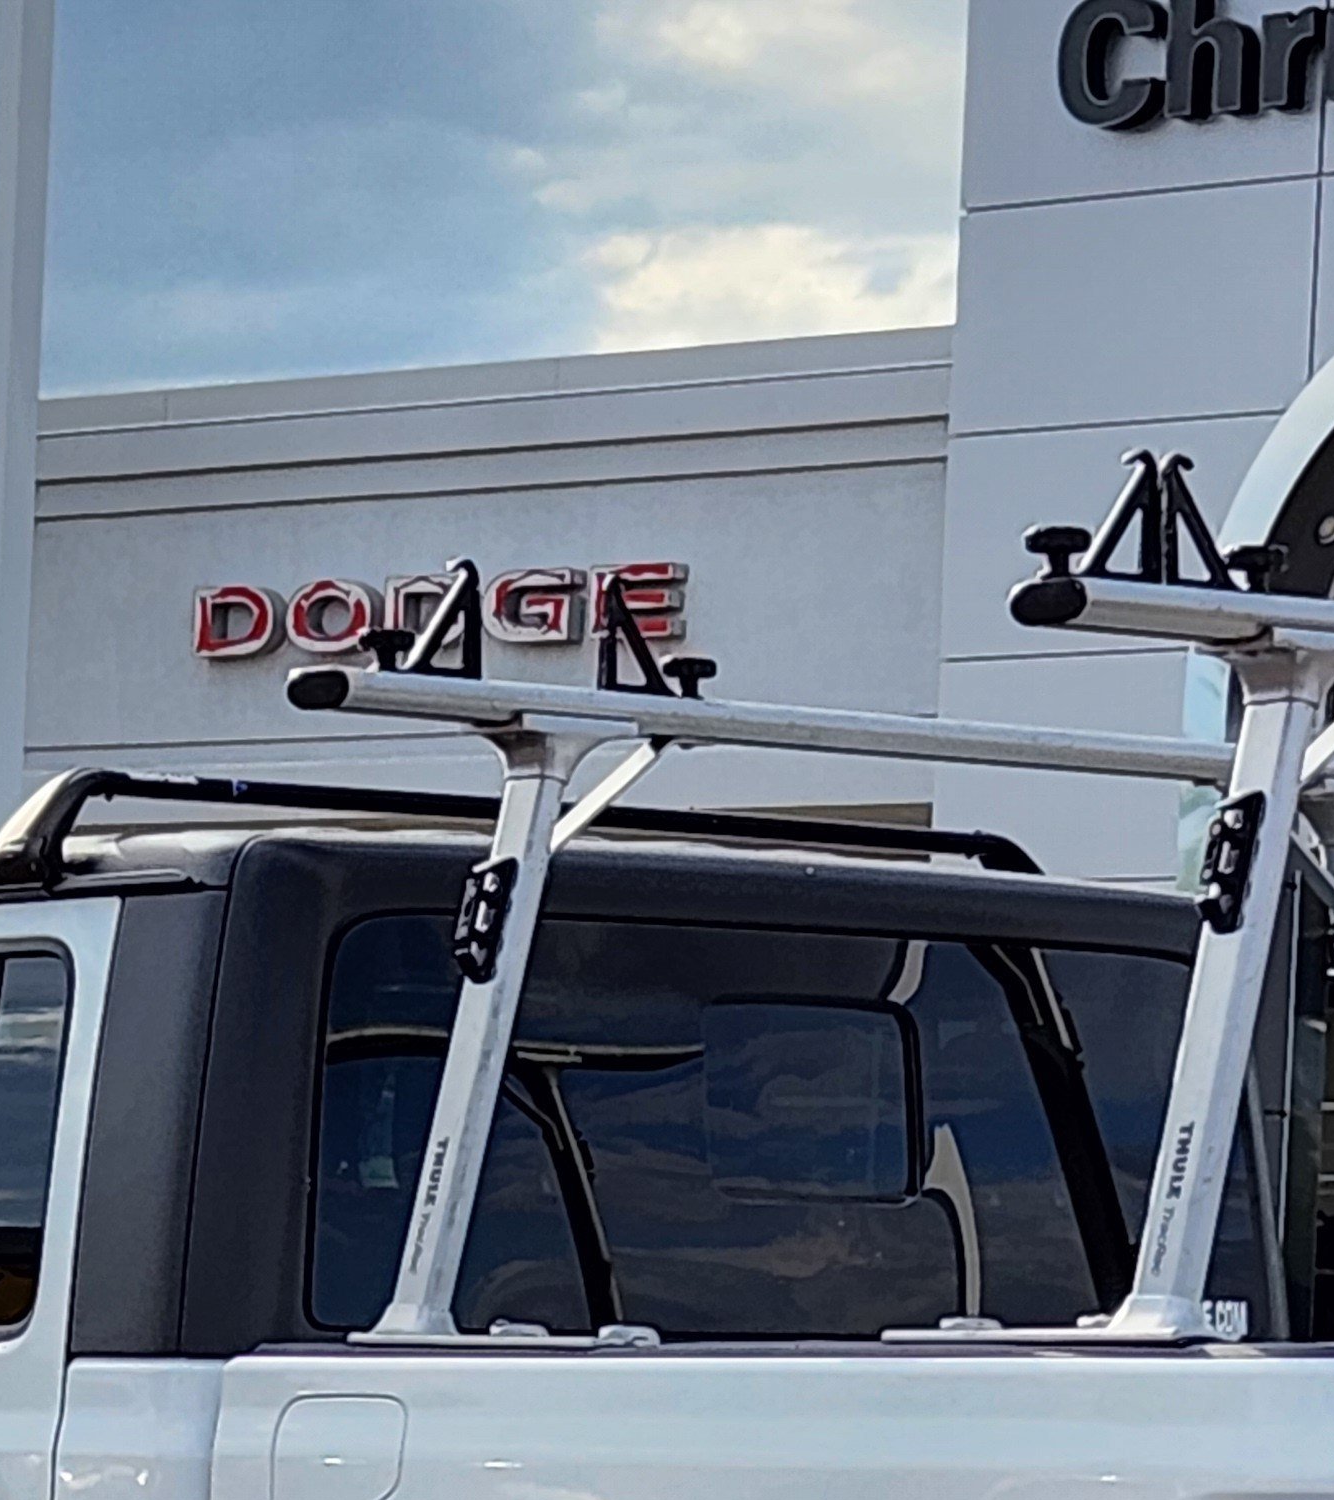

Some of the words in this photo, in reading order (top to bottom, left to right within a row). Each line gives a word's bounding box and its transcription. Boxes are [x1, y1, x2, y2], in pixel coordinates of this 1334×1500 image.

[195, 562, 689, 659] DODGE
[423, 1136, 450, 1207] THULE
[1166, 1120, 1196, 1201] THULE
